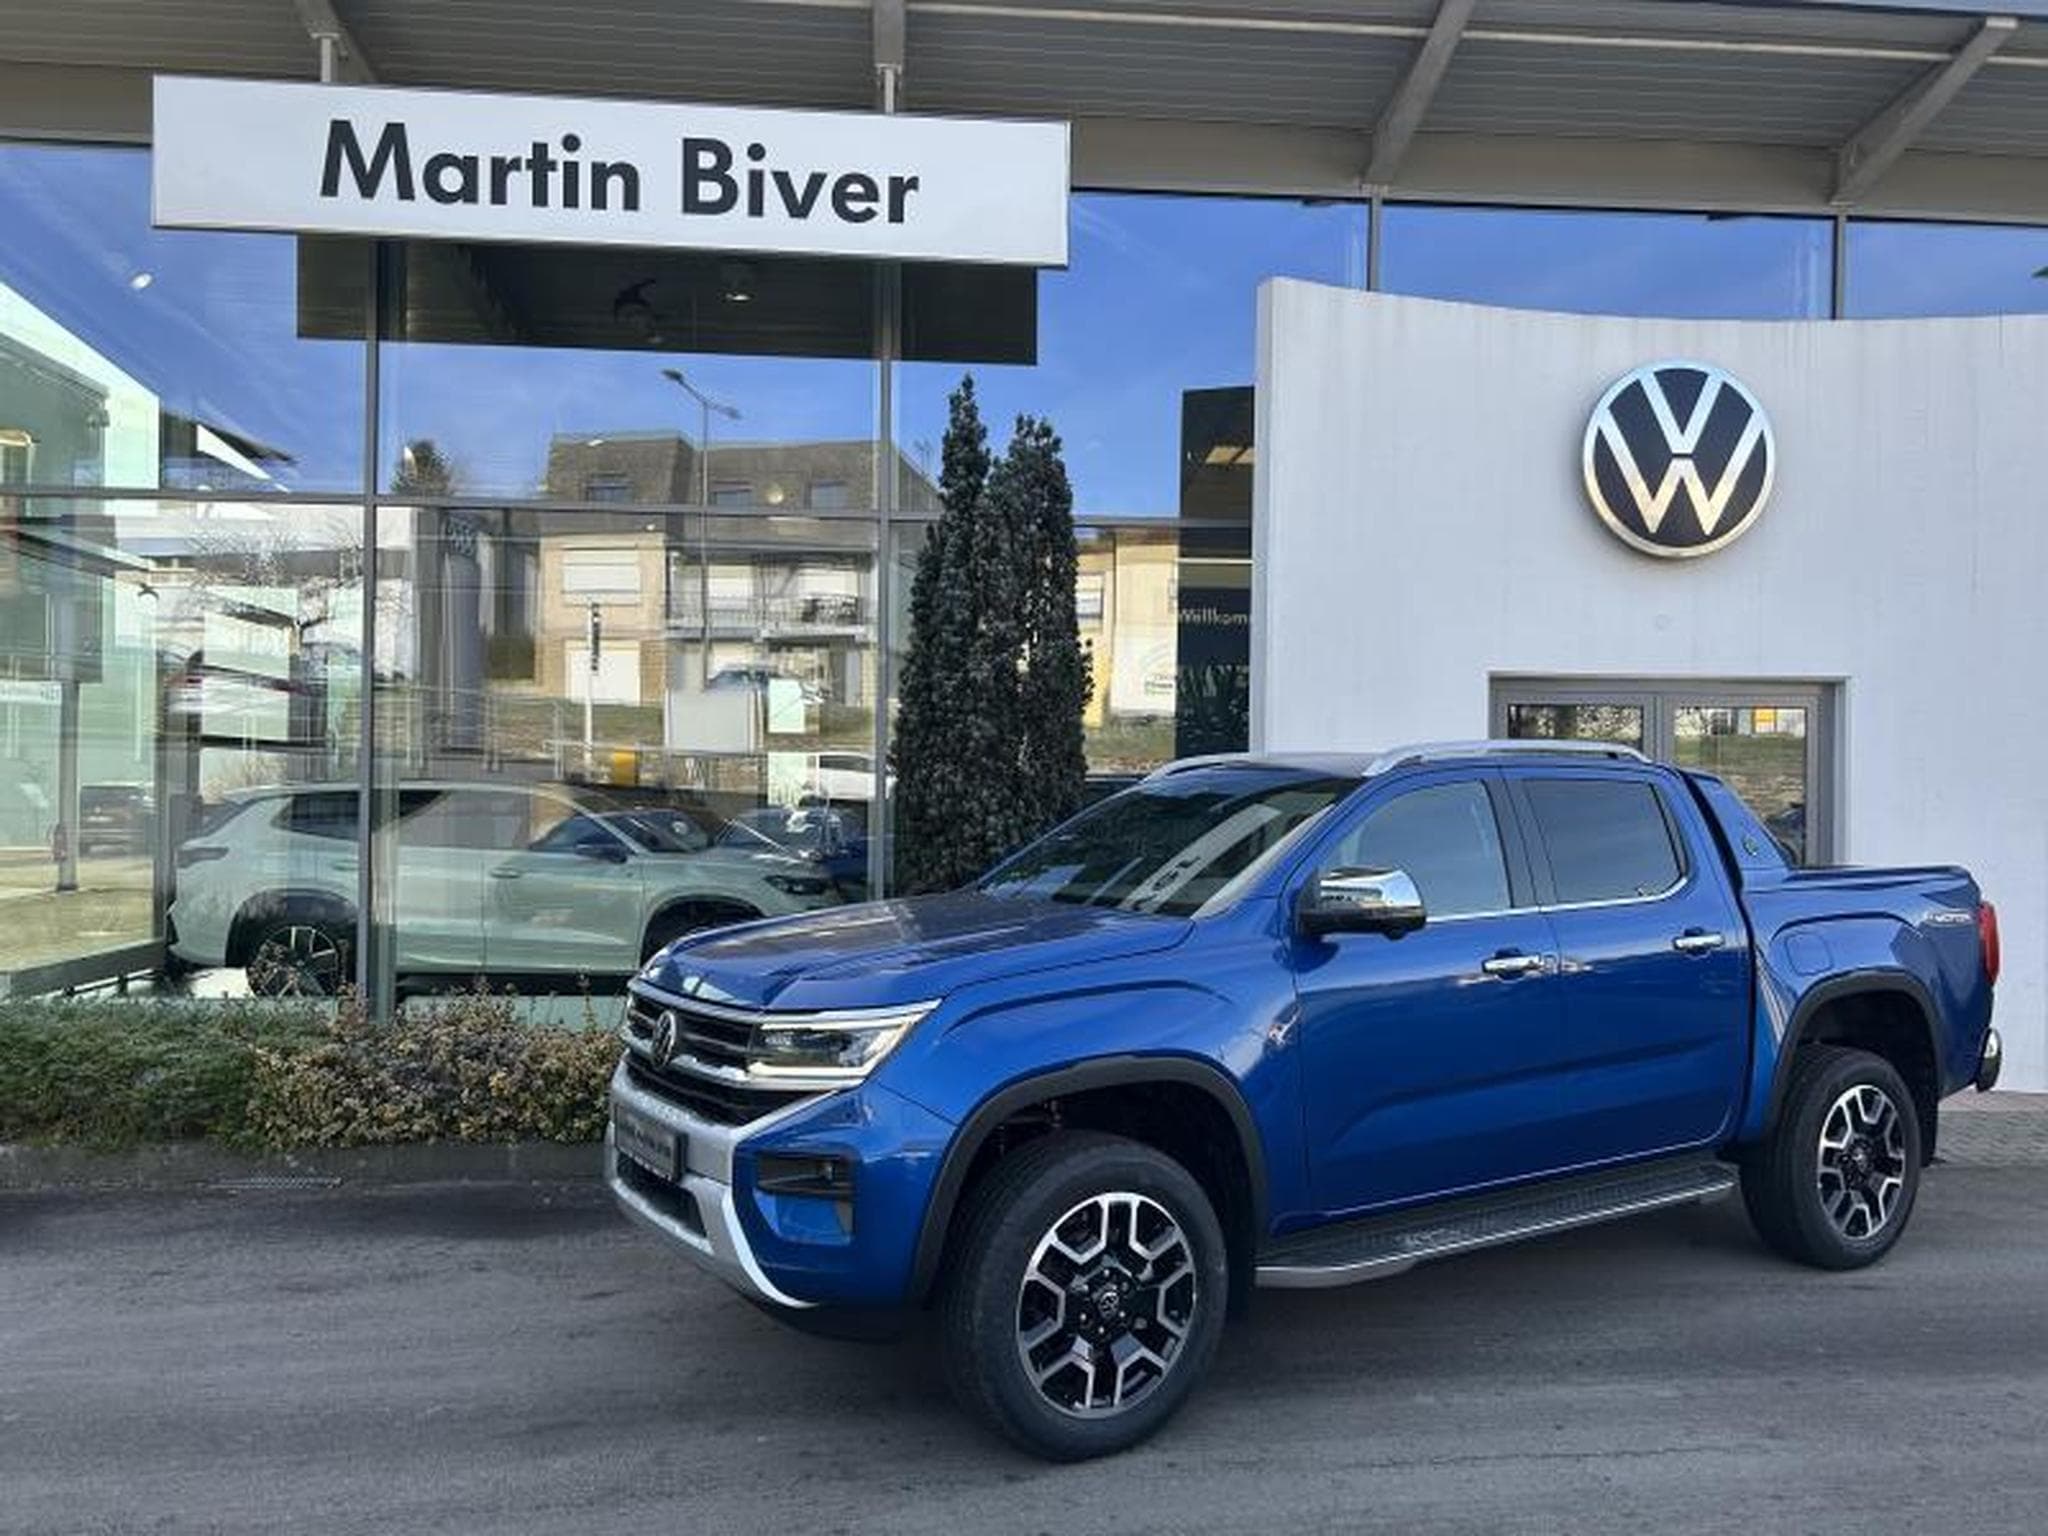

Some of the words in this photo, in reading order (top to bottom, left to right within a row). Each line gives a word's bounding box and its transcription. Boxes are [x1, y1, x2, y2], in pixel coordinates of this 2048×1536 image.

[319, 119, 641, 212] Martin
[681, 136, 920, 225] Biver
[1588, 363, 1775, 552] VW
